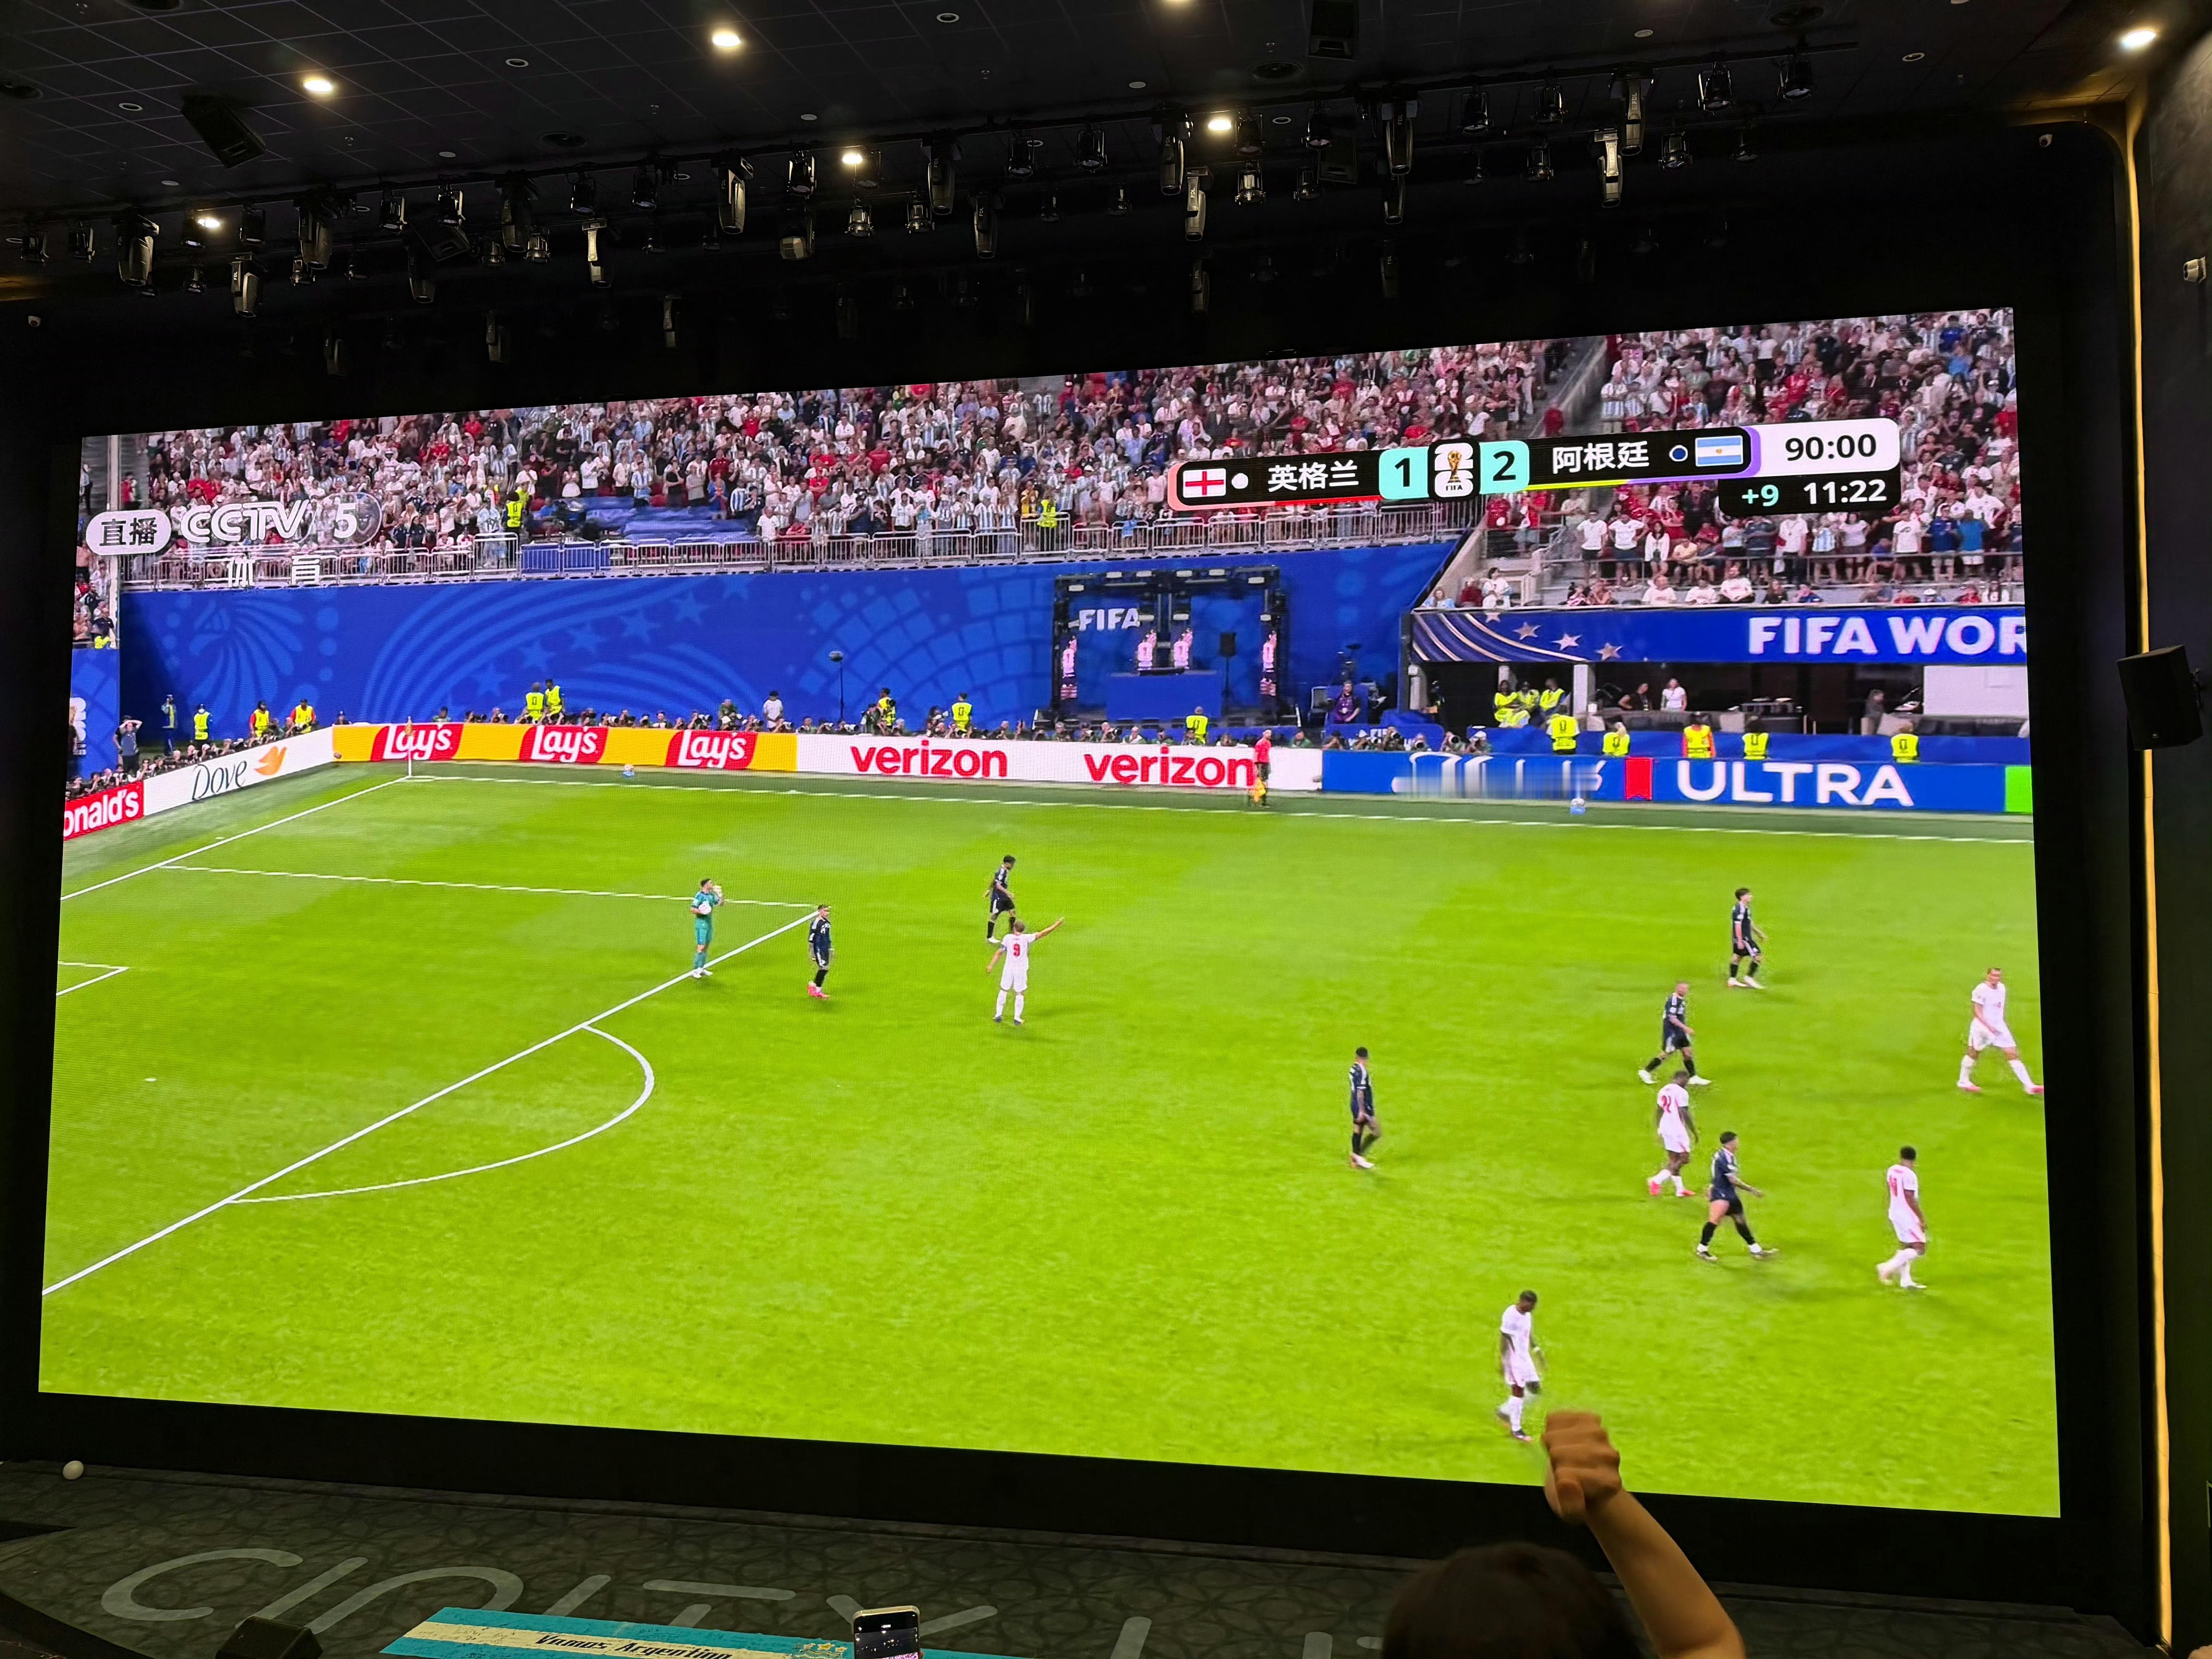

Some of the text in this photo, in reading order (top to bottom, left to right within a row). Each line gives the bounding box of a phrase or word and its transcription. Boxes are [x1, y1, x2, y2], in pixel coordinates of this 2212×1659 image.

[1552, 441, 1650, 474] 阿根廷
[1785, 434, 1876, 462] 90:00
[1267, 460, 1359, 492] 英格兰
[1395, 457, 1410, 487] 1
[1492, 450, 1516, 482] 2
[1741, 479, 1887, 507] +9 11:22
[99, 517, 158, 547] 直播
[181, 499, 357, 543] CCTV 5
[1079, 608, 1141, 631] FIFA
[1748, 615, 2027, 655] FIFA WOR
[383, 723, 452, 760] Lay's
[531, 725, 598, 763] Lay's
[677, 729, 747, 769] Lay's
[850, 740, 1008, 778] verizon
[192, 760, 247, 800] Dove
[1084, 745, 1257, 788] verizon
[1677, 760, 1914, 807] ULTRA
[535, 1635, 613, 1649] Vamos
